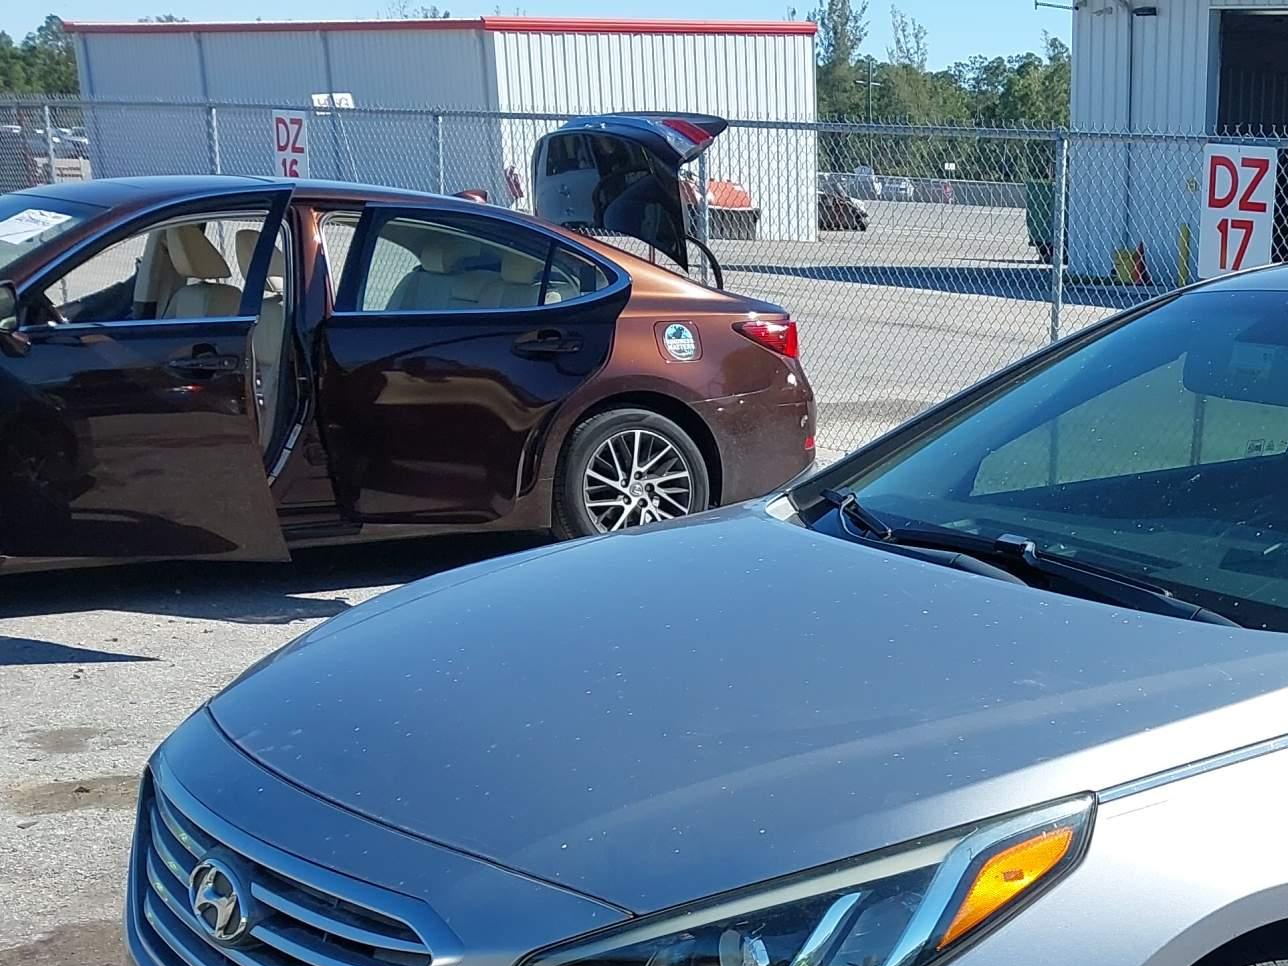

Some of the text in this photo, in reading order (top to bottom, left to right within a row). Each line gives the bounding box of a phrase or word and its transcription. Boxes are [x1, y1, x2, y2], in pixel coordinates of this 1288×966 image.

[275, 117, 305, 154] DZ
[1207, 155, 1270, 213] DZ
[1216, 218, 1254, 271] 17
